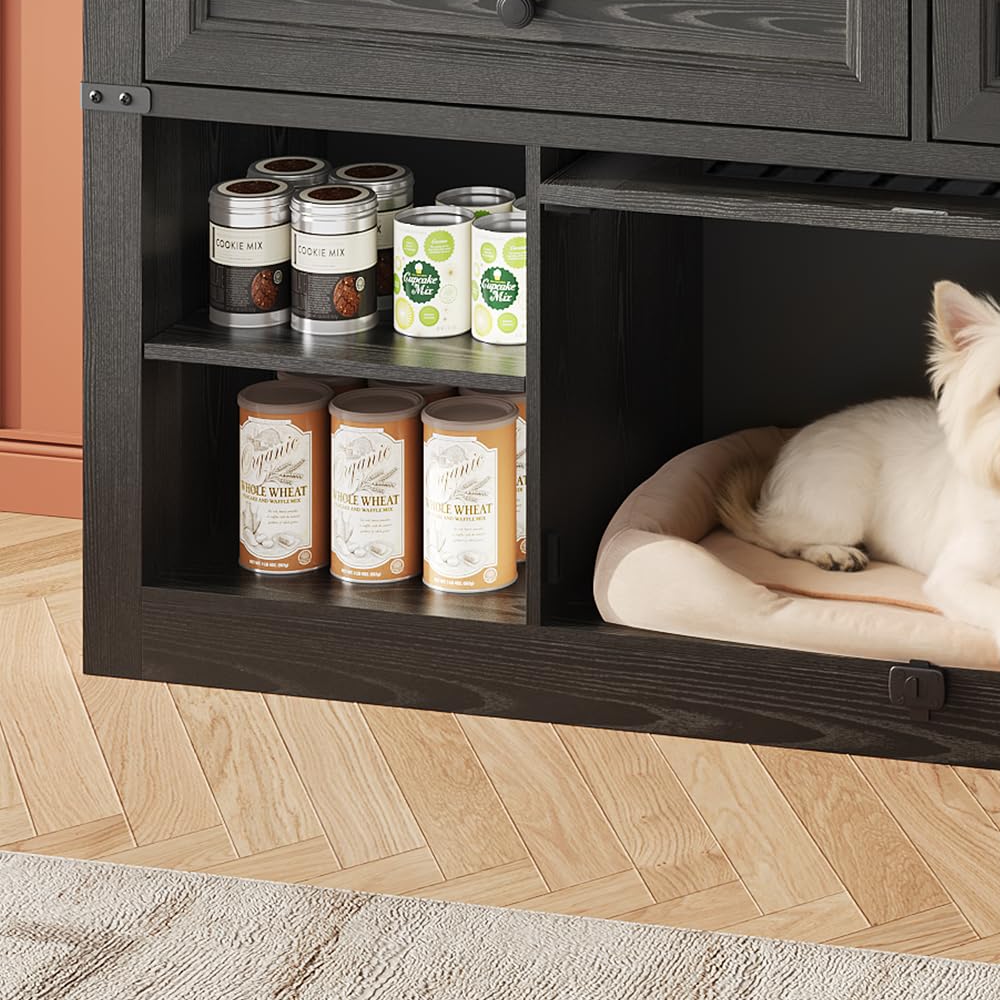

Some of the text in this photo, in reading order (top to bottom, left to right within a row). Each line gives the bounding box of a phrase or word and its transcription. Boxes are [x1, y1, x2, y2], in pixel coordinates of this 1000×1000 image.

[216, 238, 263, 250] COOKIE MIX
[298, 245, 345, 257] COOKIE MIX
[403, 272, 438, 285] Cupcake
[415, 284, 433, 295] Mix
[482, 279, 516, 292] Cupcake
[492, 291, 512, 302] Mix
[241, 480, 307, 497] WHOLE WHEAT
[361, 494, 400, 506] WHEAT
[454, 503, 493, 515] WHEAT
